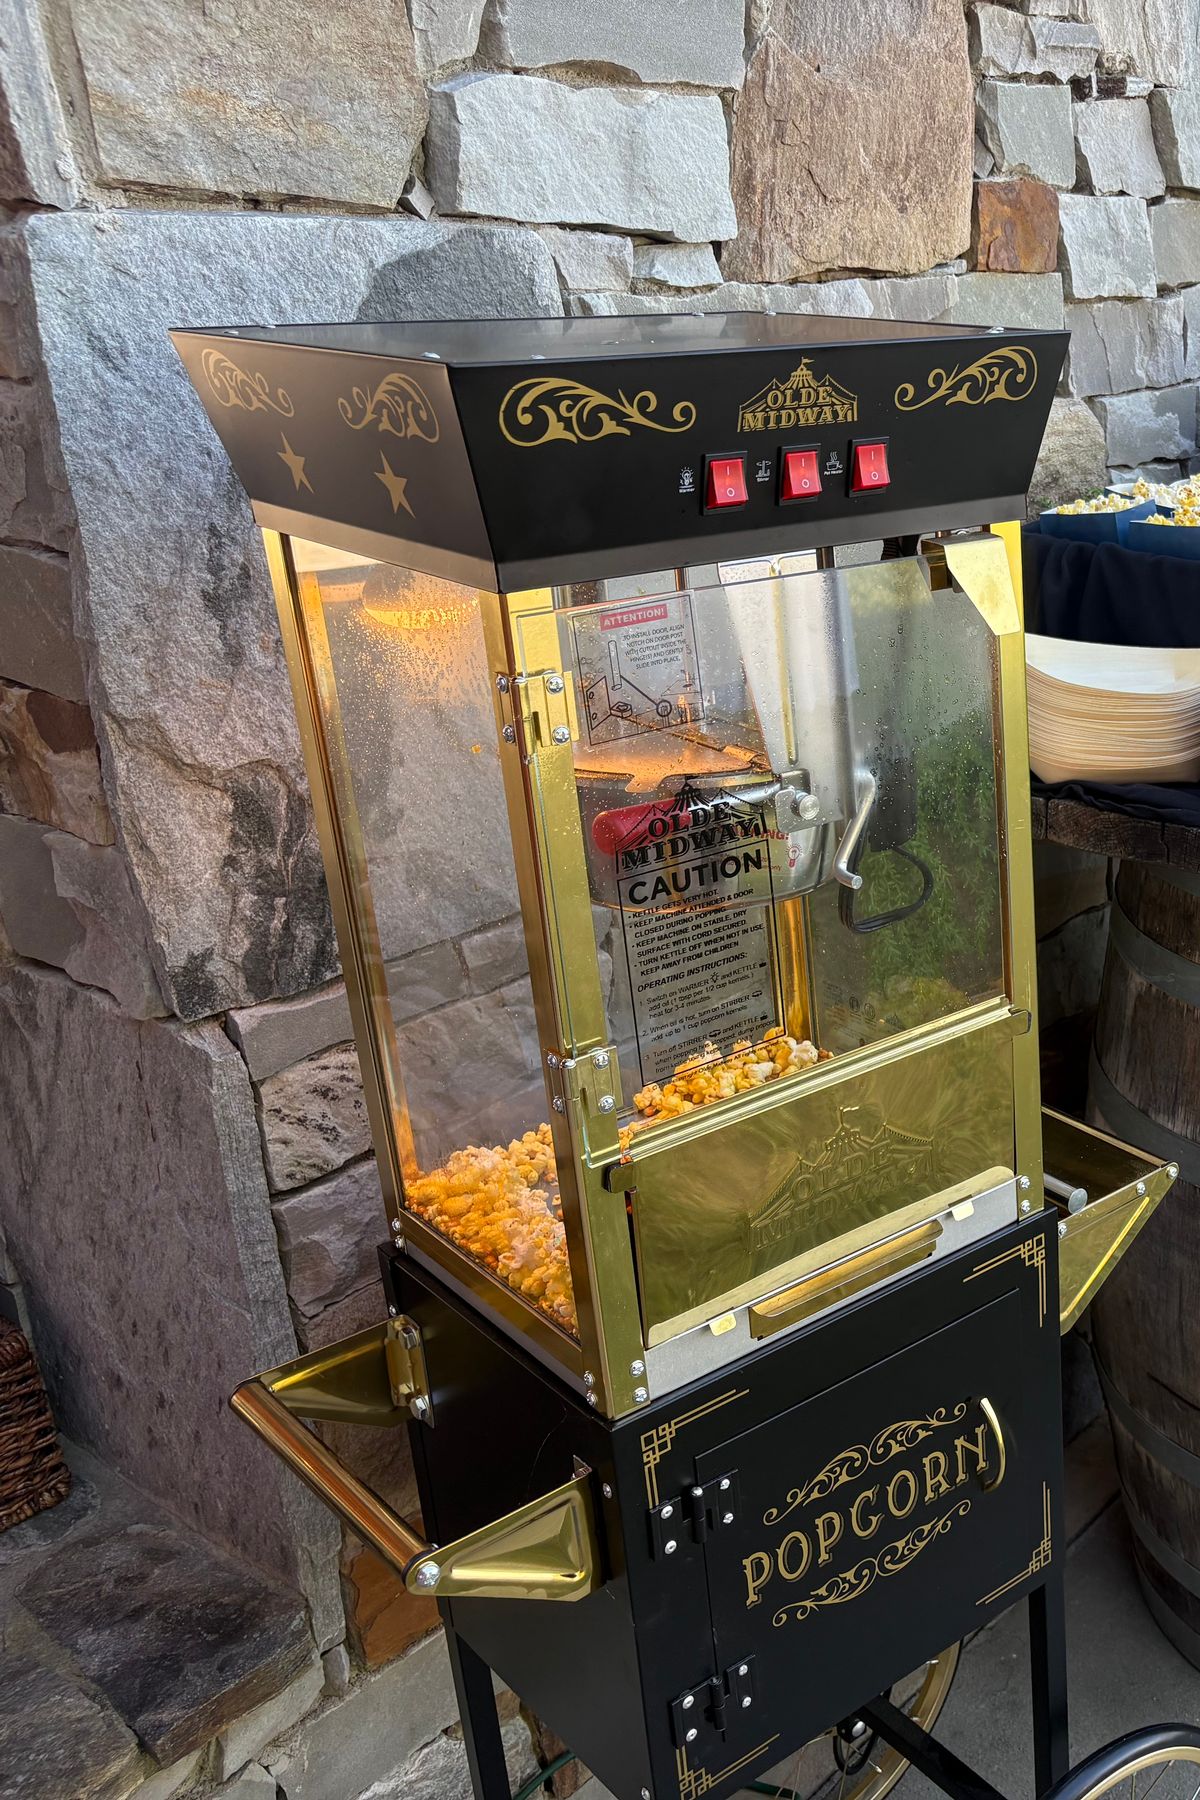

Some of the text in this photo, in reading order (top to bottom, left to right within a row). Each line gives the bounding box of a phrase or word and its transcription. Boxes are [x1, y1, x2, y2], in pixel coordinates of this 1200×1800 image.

[766, 386, 832, 409] OLDE
[742, 404, 852, 432] MIDWAY
[603, 608, 665, 627] ATTENTION!
[627, 640, 645, 648] NOTCH
[639, 645, 659, 653] CUTOUT
[661, 641, 676, 649] INSIDE
[666, 648, 684, 656] GENTLY
[636, 662, 650, 670] SLIDE
[648, 801, 733, 839] OLDE
[621, 816, 759, 872] MIDWAY
[628, 849, 763, 906] CAUTION
[633, 906, 660, 919] KETTLE
[662, 900, 681, 910] GETS
[683, 894, 701, 904] VERY
[634, 918, 654, 928] KEEP
[655, 908, 688, 922] MACHINE
[690, 897, 726, 912] ATTENDED
[734, 889, 754, 899] DOOR
[635, 925, 664, 939] CLOSED
[666, 916, 693, 929] DURING
[636, 937, 656, 948] KEEP
[657, 927, 690, 942] MACHINE
[691, 923, 702, 931] ON
[733, 910, 747, 919] DRY
[637, 943, 670, 958] SURFACE
[672, 937, 690, 947] WITH
[692, 930, 712, 941] CORD
[639, 956, 658, 967] TURN
[660, 947, 687, 961] KETTLE
[689, 943, 703, 952] OFF
[704, 936, 725, 947] WHEN
[727, 931, 740, 940] NOT
[638, 952, 748, 992] OPERATING INSTRUCTIONS:
[641, 966, 660, 977] KEEP
[661, 959, 681, 970] AWAY
[683, 952, 703, 963] FROM
[647, 993, 667, 1004] Switch
[678, 979, 709, 994] WARMER
[721, 972, 732, 980] and
[733, 963, 758, 976] KETTLE
[650, 1023, 668, 1034] When
[721, 995, 750, 1010] STIRRER
[678, 1034, 708, 1049] STIRRER
[722, 1025, 733, 1034] and
[735, 1015, 759, 1029] KETTLE
[742, 1424, 989, 1609] POPCORN
